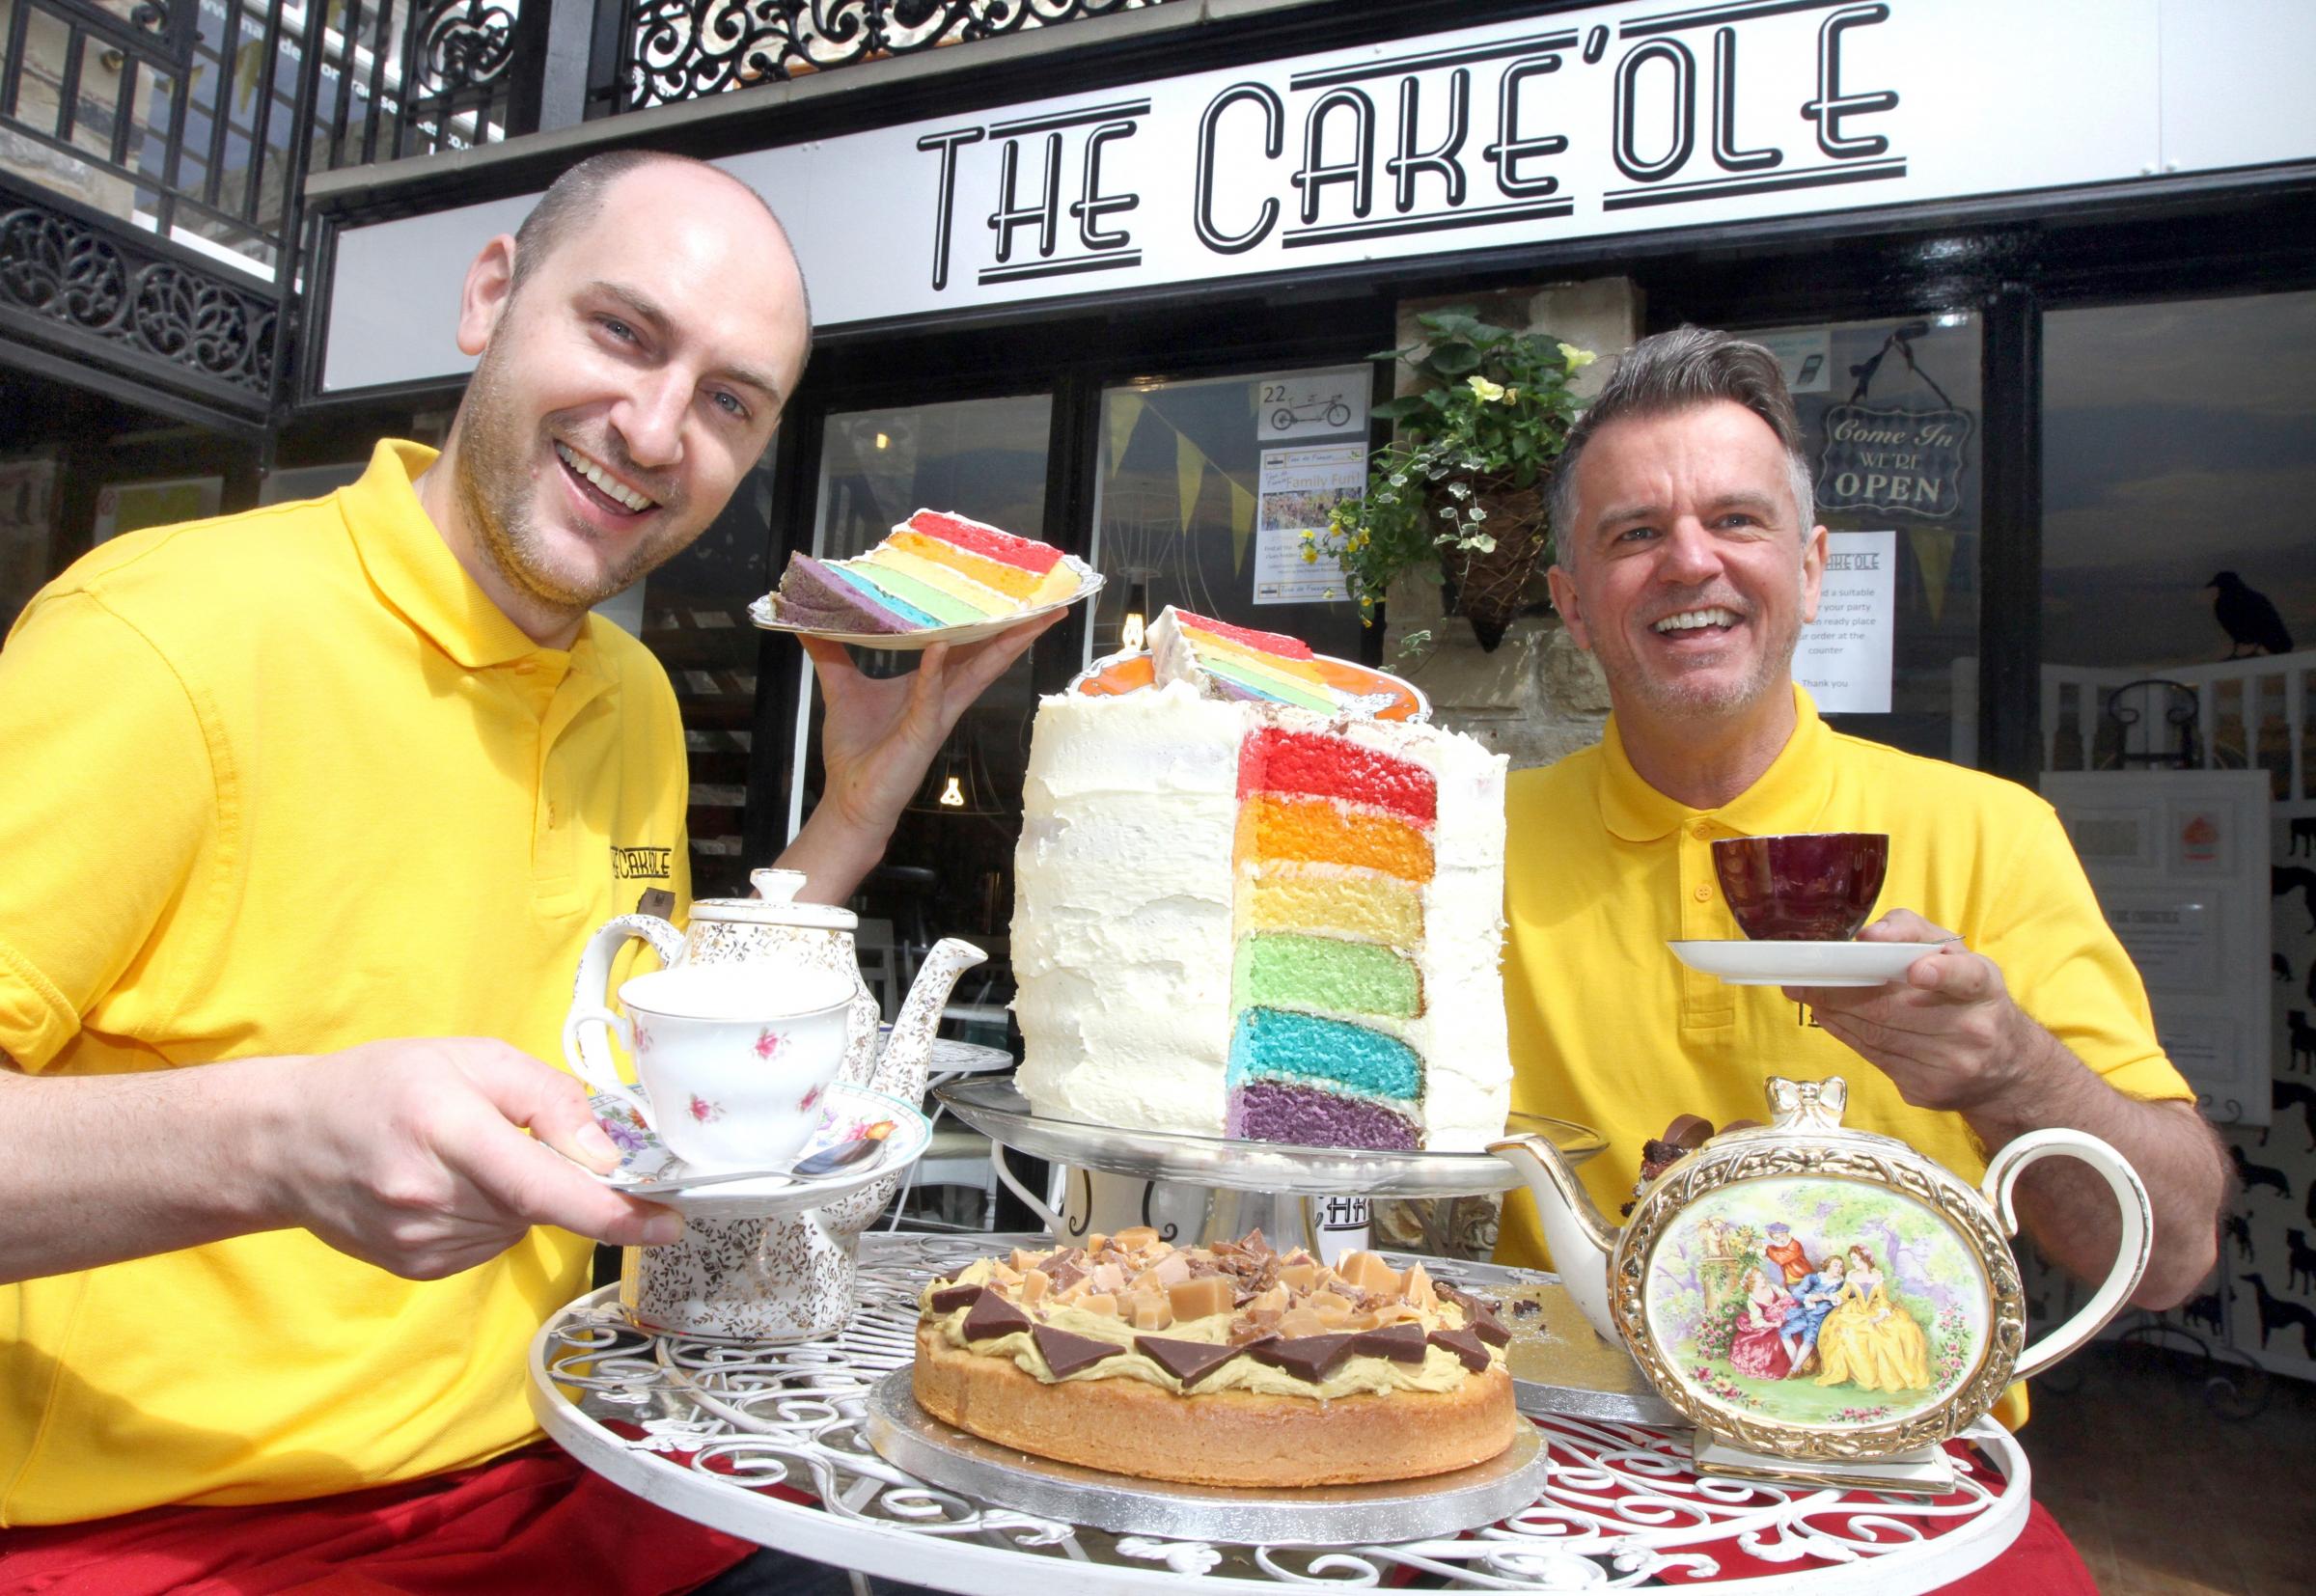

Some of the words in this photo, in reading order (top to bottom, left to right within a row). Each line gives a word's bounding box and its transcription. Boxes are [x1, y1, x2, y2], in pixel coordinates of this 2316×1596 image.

[916, 121, 1139, 291] THE
[1194, 3, 1900, 254] CAKE'OLE
[1263, 386, 1285, 403] 22
[1834, 419, 1906, 445] Come
[1914, 424, 1954, 448] In
[1861, 452, 1922, 471] WE'RE
[1286, 474, 1328, 489] Family
[1835, 472, 1941, 504] OPEN
[1838, 589, 1875, 597] suitable
[1846, 604, 1871, 613] party
[1824, 618, 1850, 626] ready
[1852, 618, 1876, 626] place
[1802, 679, 1829, 688] Thank
[1831, 680, 1848, 689] you
